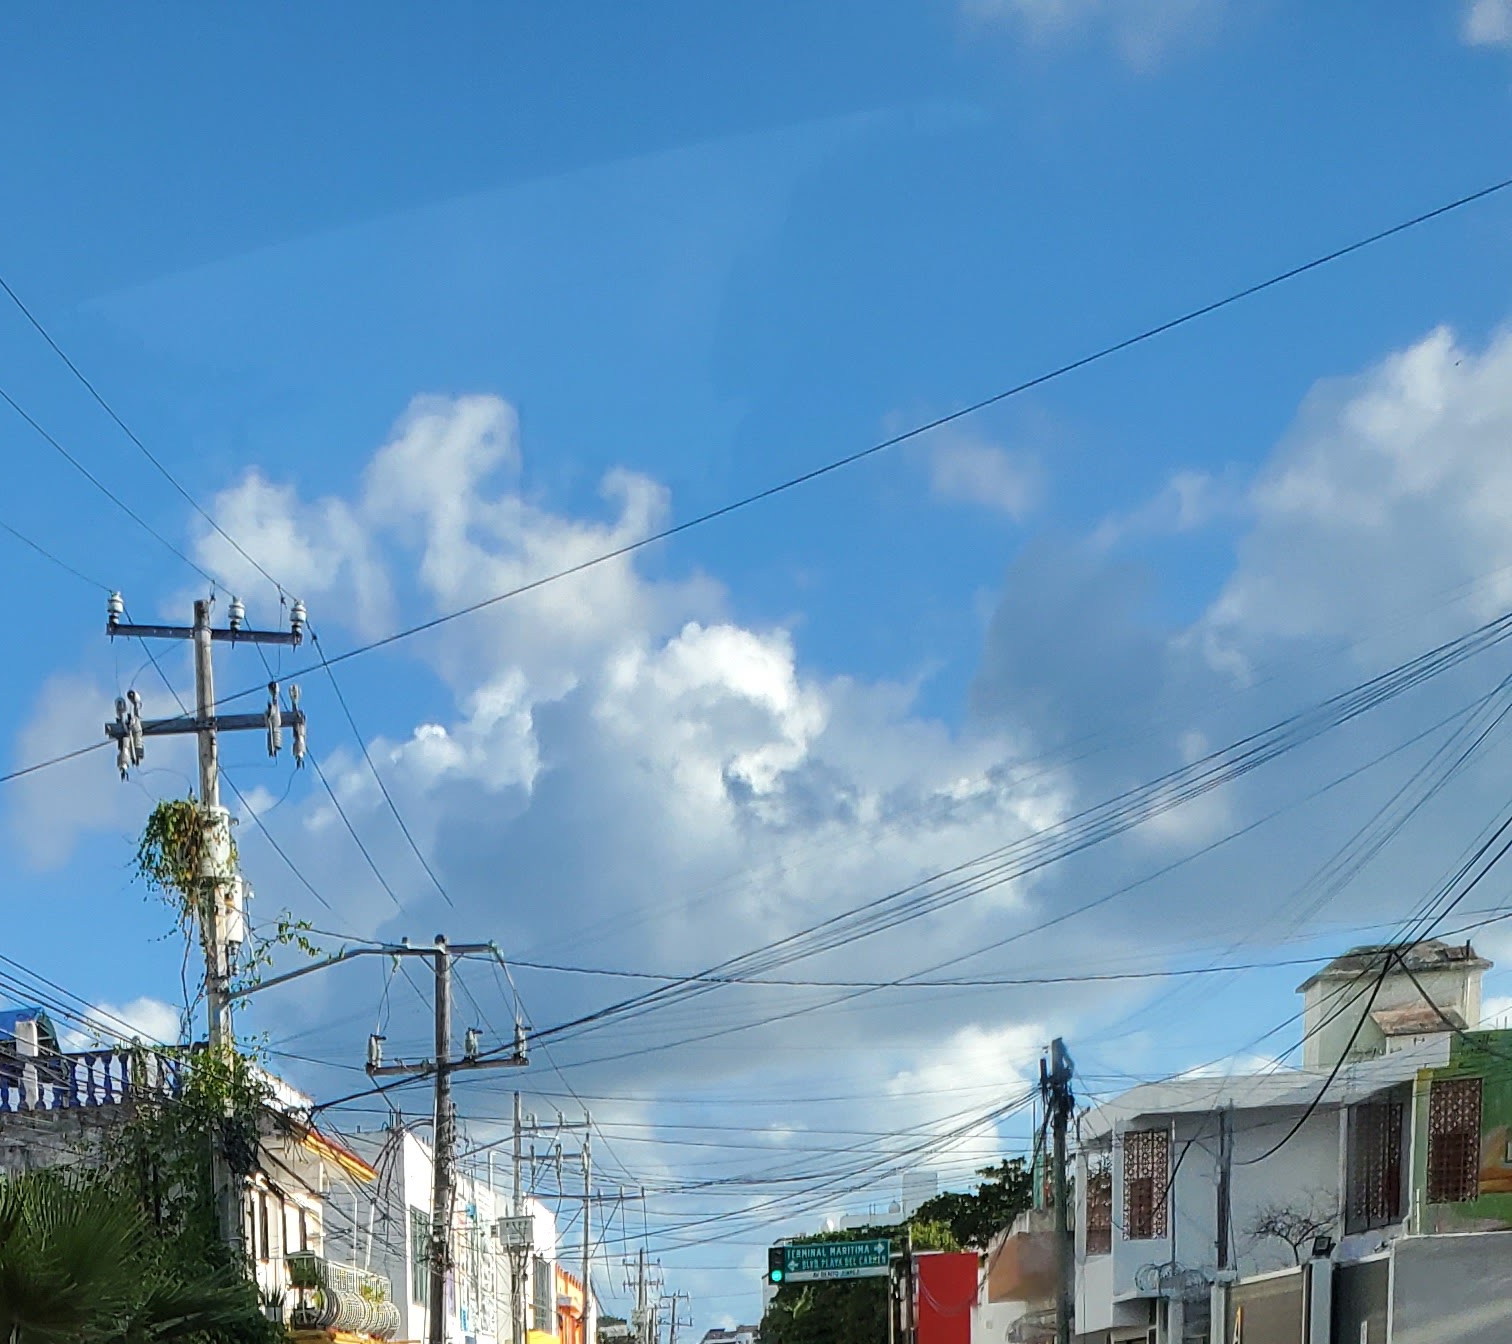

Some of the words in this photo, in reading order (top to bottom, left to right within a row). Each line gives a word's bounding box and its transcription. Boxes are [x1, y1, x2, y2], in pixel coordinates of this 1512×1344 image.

[788, 1247, 826, 1259] TERMINAL
[830, 1244, 870, 1257] MARITIMA
[822, 1257, 843, 1269] PLAYA
